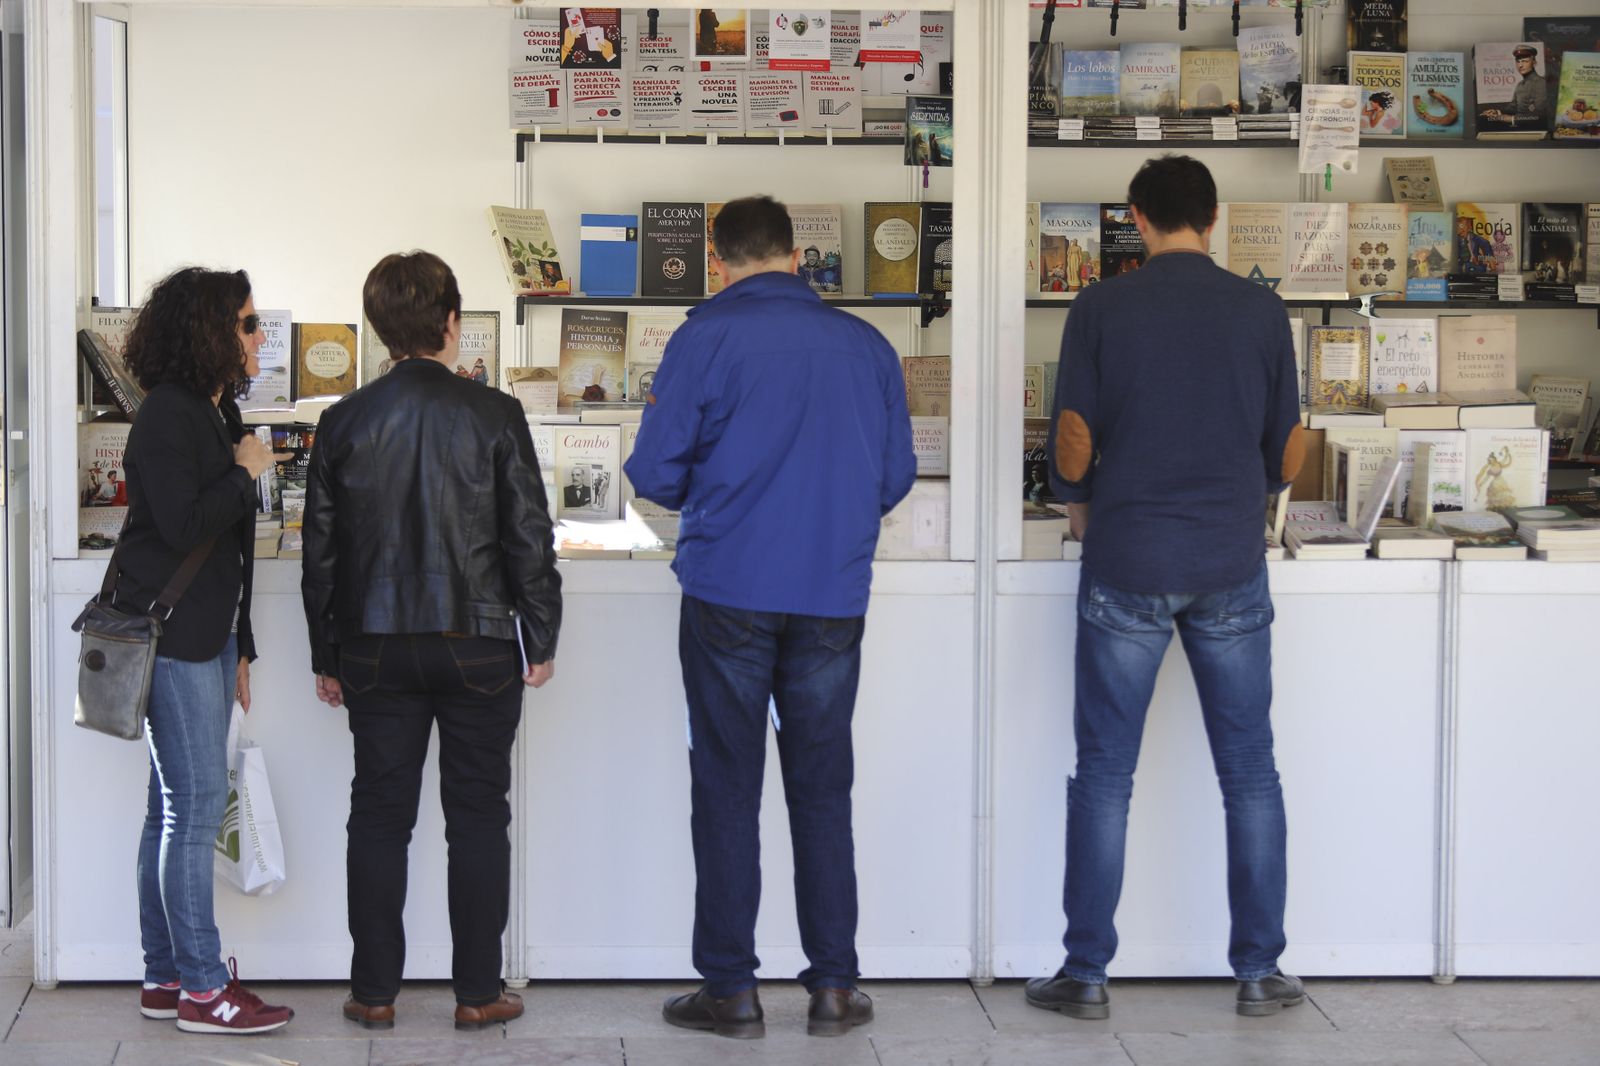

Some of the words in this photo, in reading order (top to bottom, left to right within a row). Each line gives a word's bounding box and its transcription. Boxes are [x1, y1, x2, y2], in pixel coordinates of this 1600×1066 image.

[920, 24, 944, 32] QUÉ?
[523, 29, 551, 37] CÓMO
[1068, 62, 1086, 73] Los
[1123, 64, 1177, 74] ALMIRANTE
[1356, 68, 1384, 76] TODOS
[1414, 64, 1458, 73] AMULETOS
[1356, 76, 1401, 88] SUEÑOS
[1411, 74, 1460, 82] TALISMANES
[1484, 76, 1516, 85] ROJO
[648, 208, 660, 218] EL
[662, 208, 702, 219] CORÁN
[1231, 225, 1282, 234] HISTORIA
[1306, 221, 1328, 230] DIEZ
[1232, 236, 1243, 244] de
[1243, 236, 1280, 244] ISRAEL
[1294, 232, 1340, 240] RAZONES
[1304, 242, 1330, 251] PARA
[1321, 253, 1335, 262] DE
[1290, 264, 1344, 273] DERECHAS
[567, 325, 625, 335] ROSACRUCES,
[570, 334, 613, 343] HISTORIA
[639, 338, 650, 347] de
[567, 342, 622, 352] PERSONAJES
[1386, 348, 1395, 362] El
[1398, 349, 1420, 361] reto
[1377, 364, 1431, 377] energético
[564, 434, 610, 448] Cambó
[100, 460, 110, 468] de
[212, 1000, 240, 1022] N
